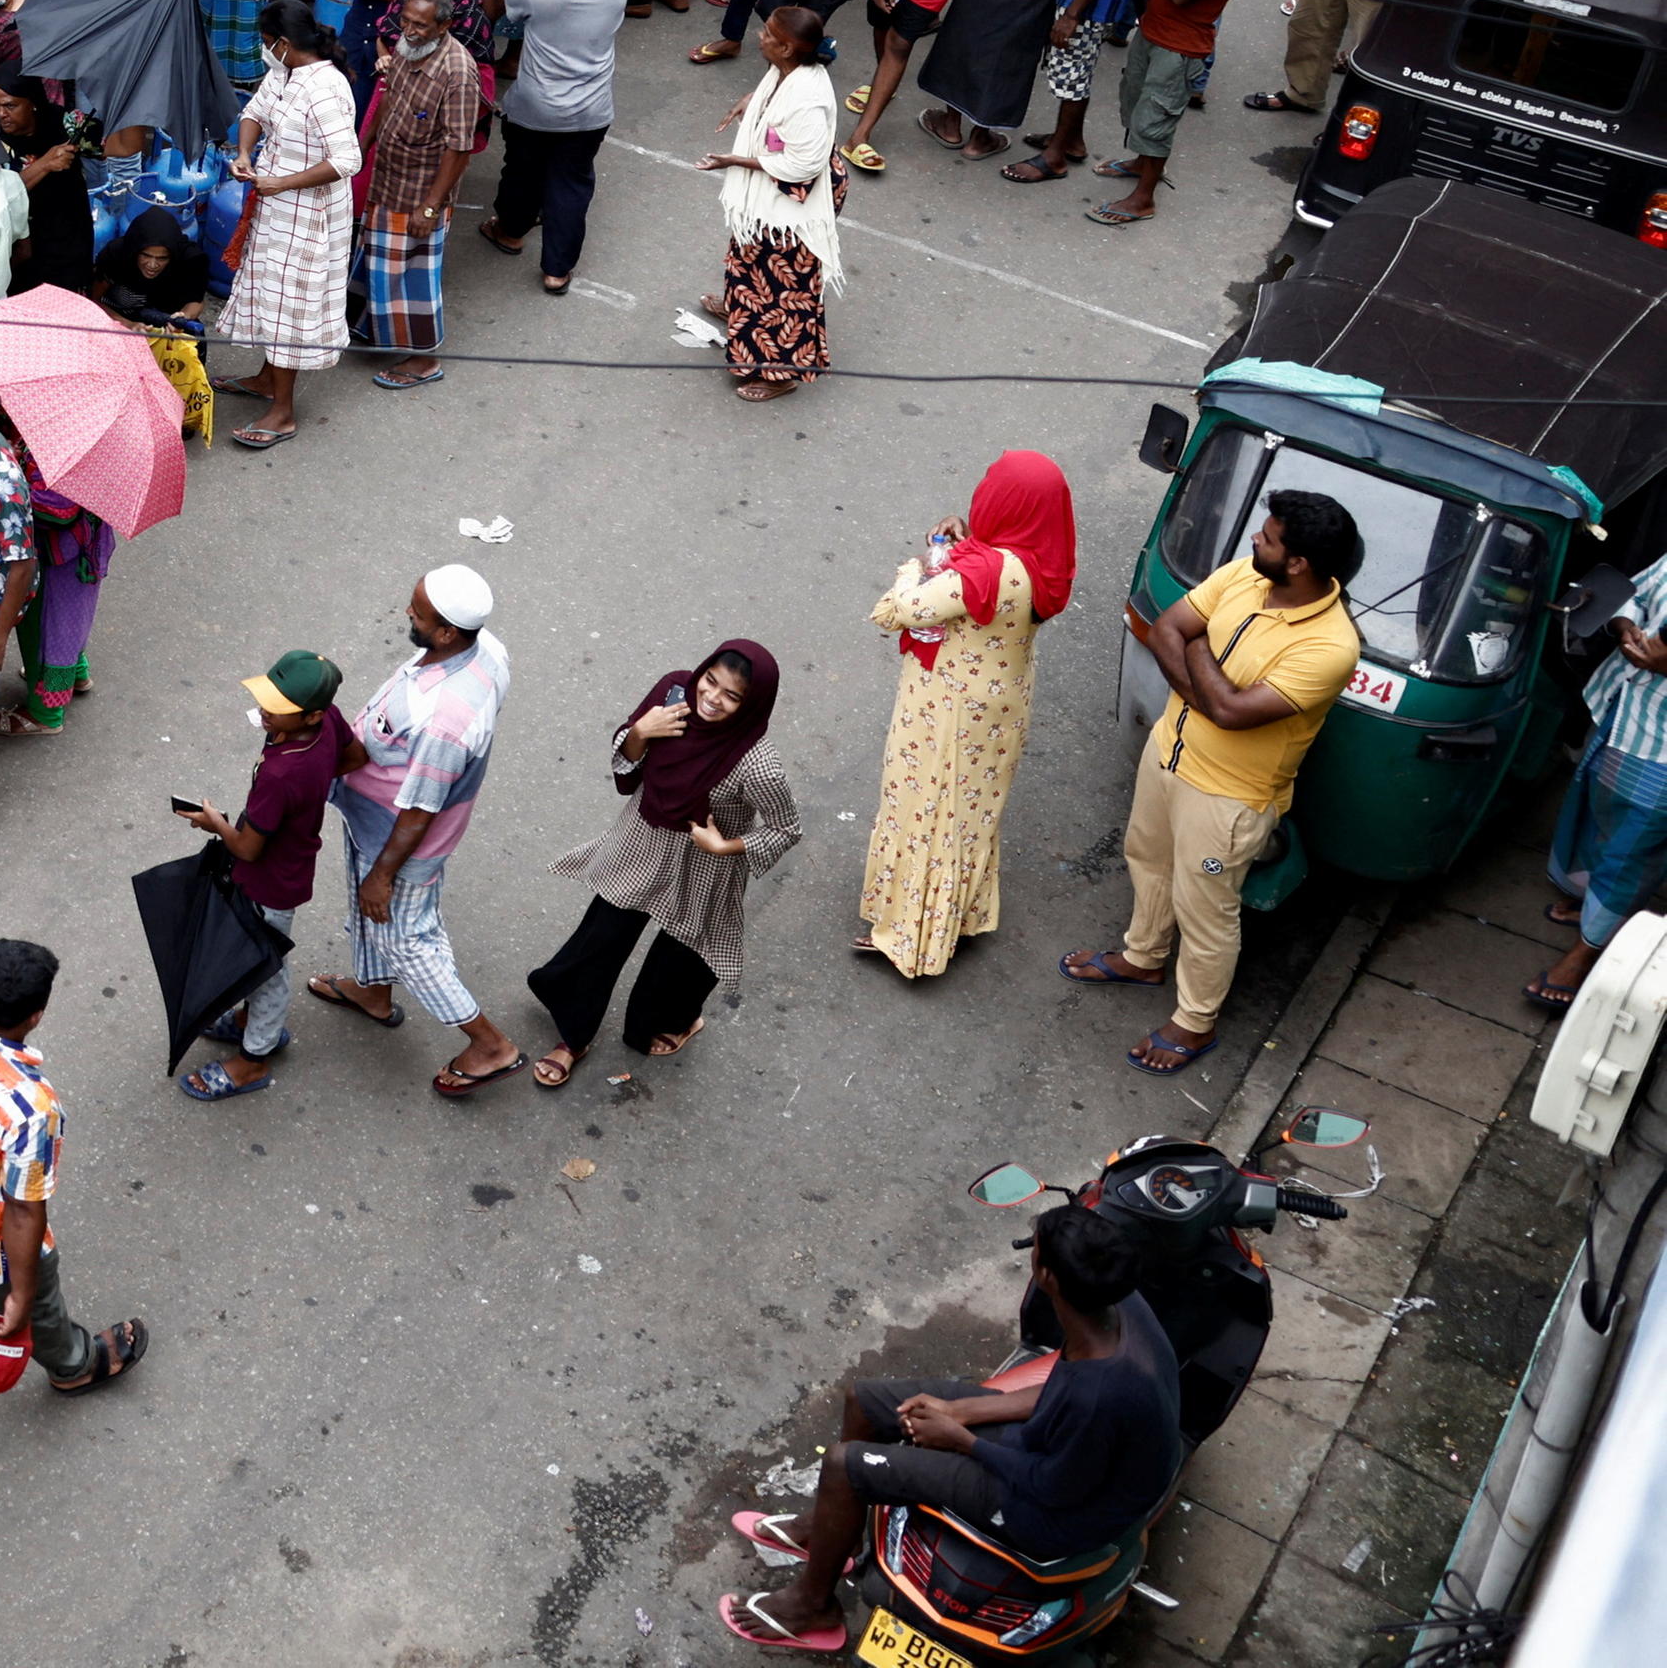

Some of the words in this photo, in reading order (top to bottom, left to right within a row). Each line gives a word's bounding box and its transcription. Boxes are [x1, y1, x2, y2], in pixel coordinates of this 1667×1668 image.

[1491, 126, 1545, 152] TVS
[933, 1588, 969, 1615] STOP
[870, 1627, 896, 1650] WP
